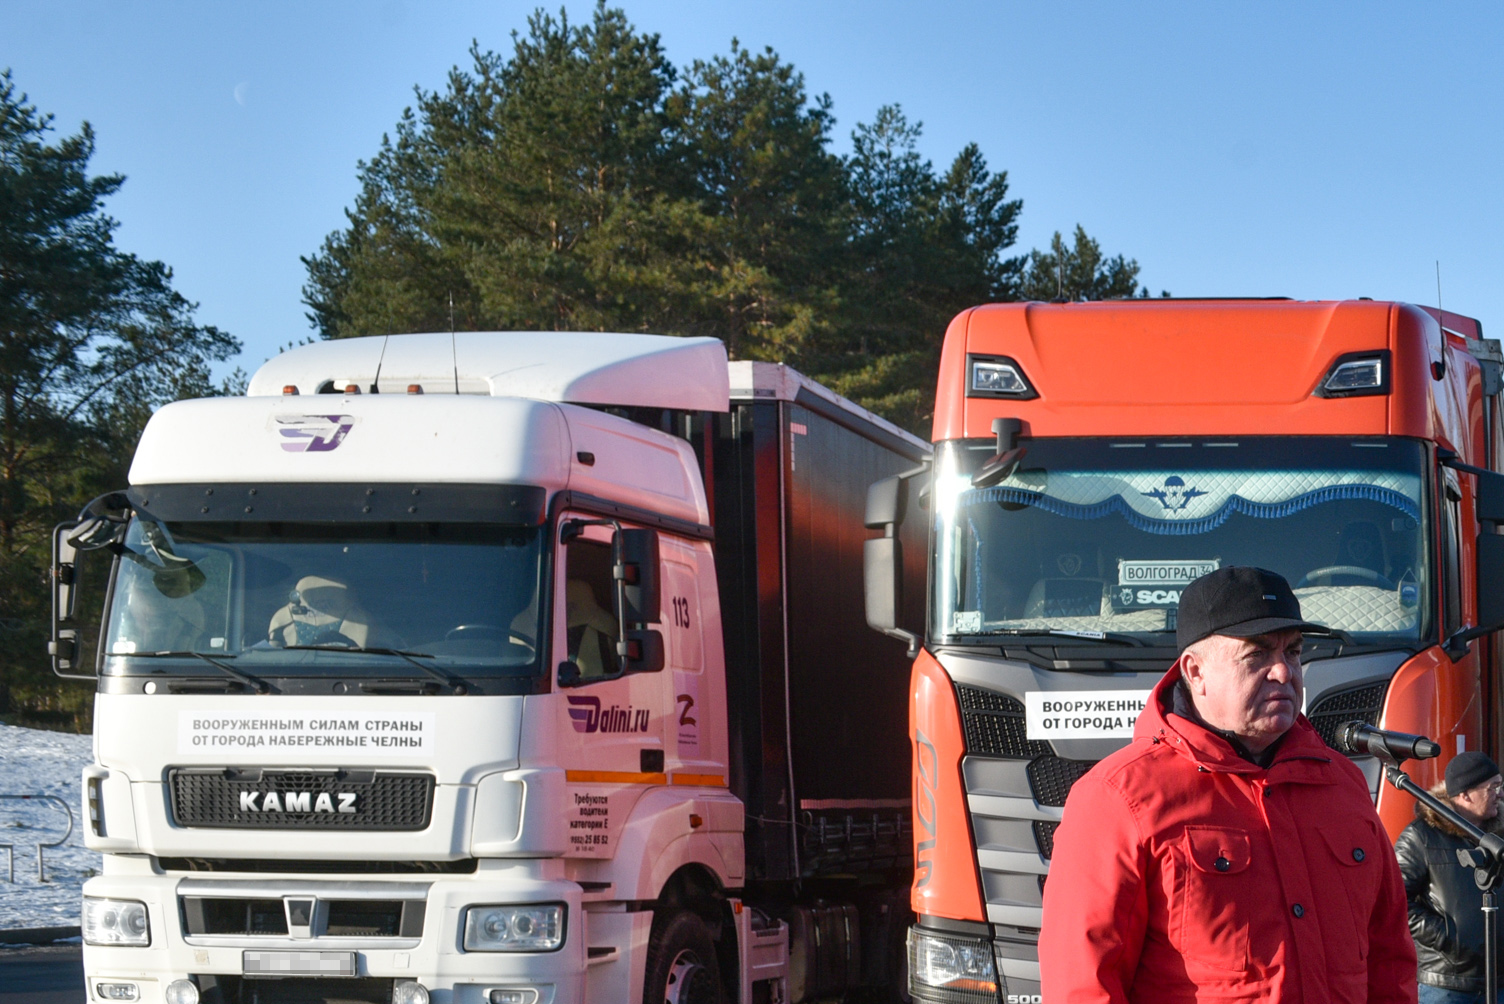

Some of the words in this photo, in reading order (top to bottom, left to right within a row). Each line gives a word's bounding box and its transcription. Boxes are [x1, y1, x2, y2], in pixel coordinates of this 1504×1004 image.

[1128, 567, 1198, 580] ВОЛГОГРАД
[672, 596, 690, 629] 113
[567, 695, 650, 733] Dalini.ru
[192, 719, 304, 730] ВООРУЖЕННЫМ
[309, 719, 360, 731] СИЛАМ
[365, 720, 423, 732] СТРАНЫ
[1043, 718, 1060, 729] ОТ
[1065, 717, 1123, 730] ГОРОДА
[192, 735, 208, 746] ОТ
[212, 735, 265, 748] ГОРОДА
[269, 735, 368, 747] НАБЕРЕЖНЫЕ
[371, 736, 423, 747] ЧЕЛНЫ
[239, 791, 357, 813] KAMAZ
[574, 793, 608, 806] Требуются
[580, 807, 608, 817] водители
[570, 820, 602, 830] категории
[1007, 994, 1042, 1004] 500
